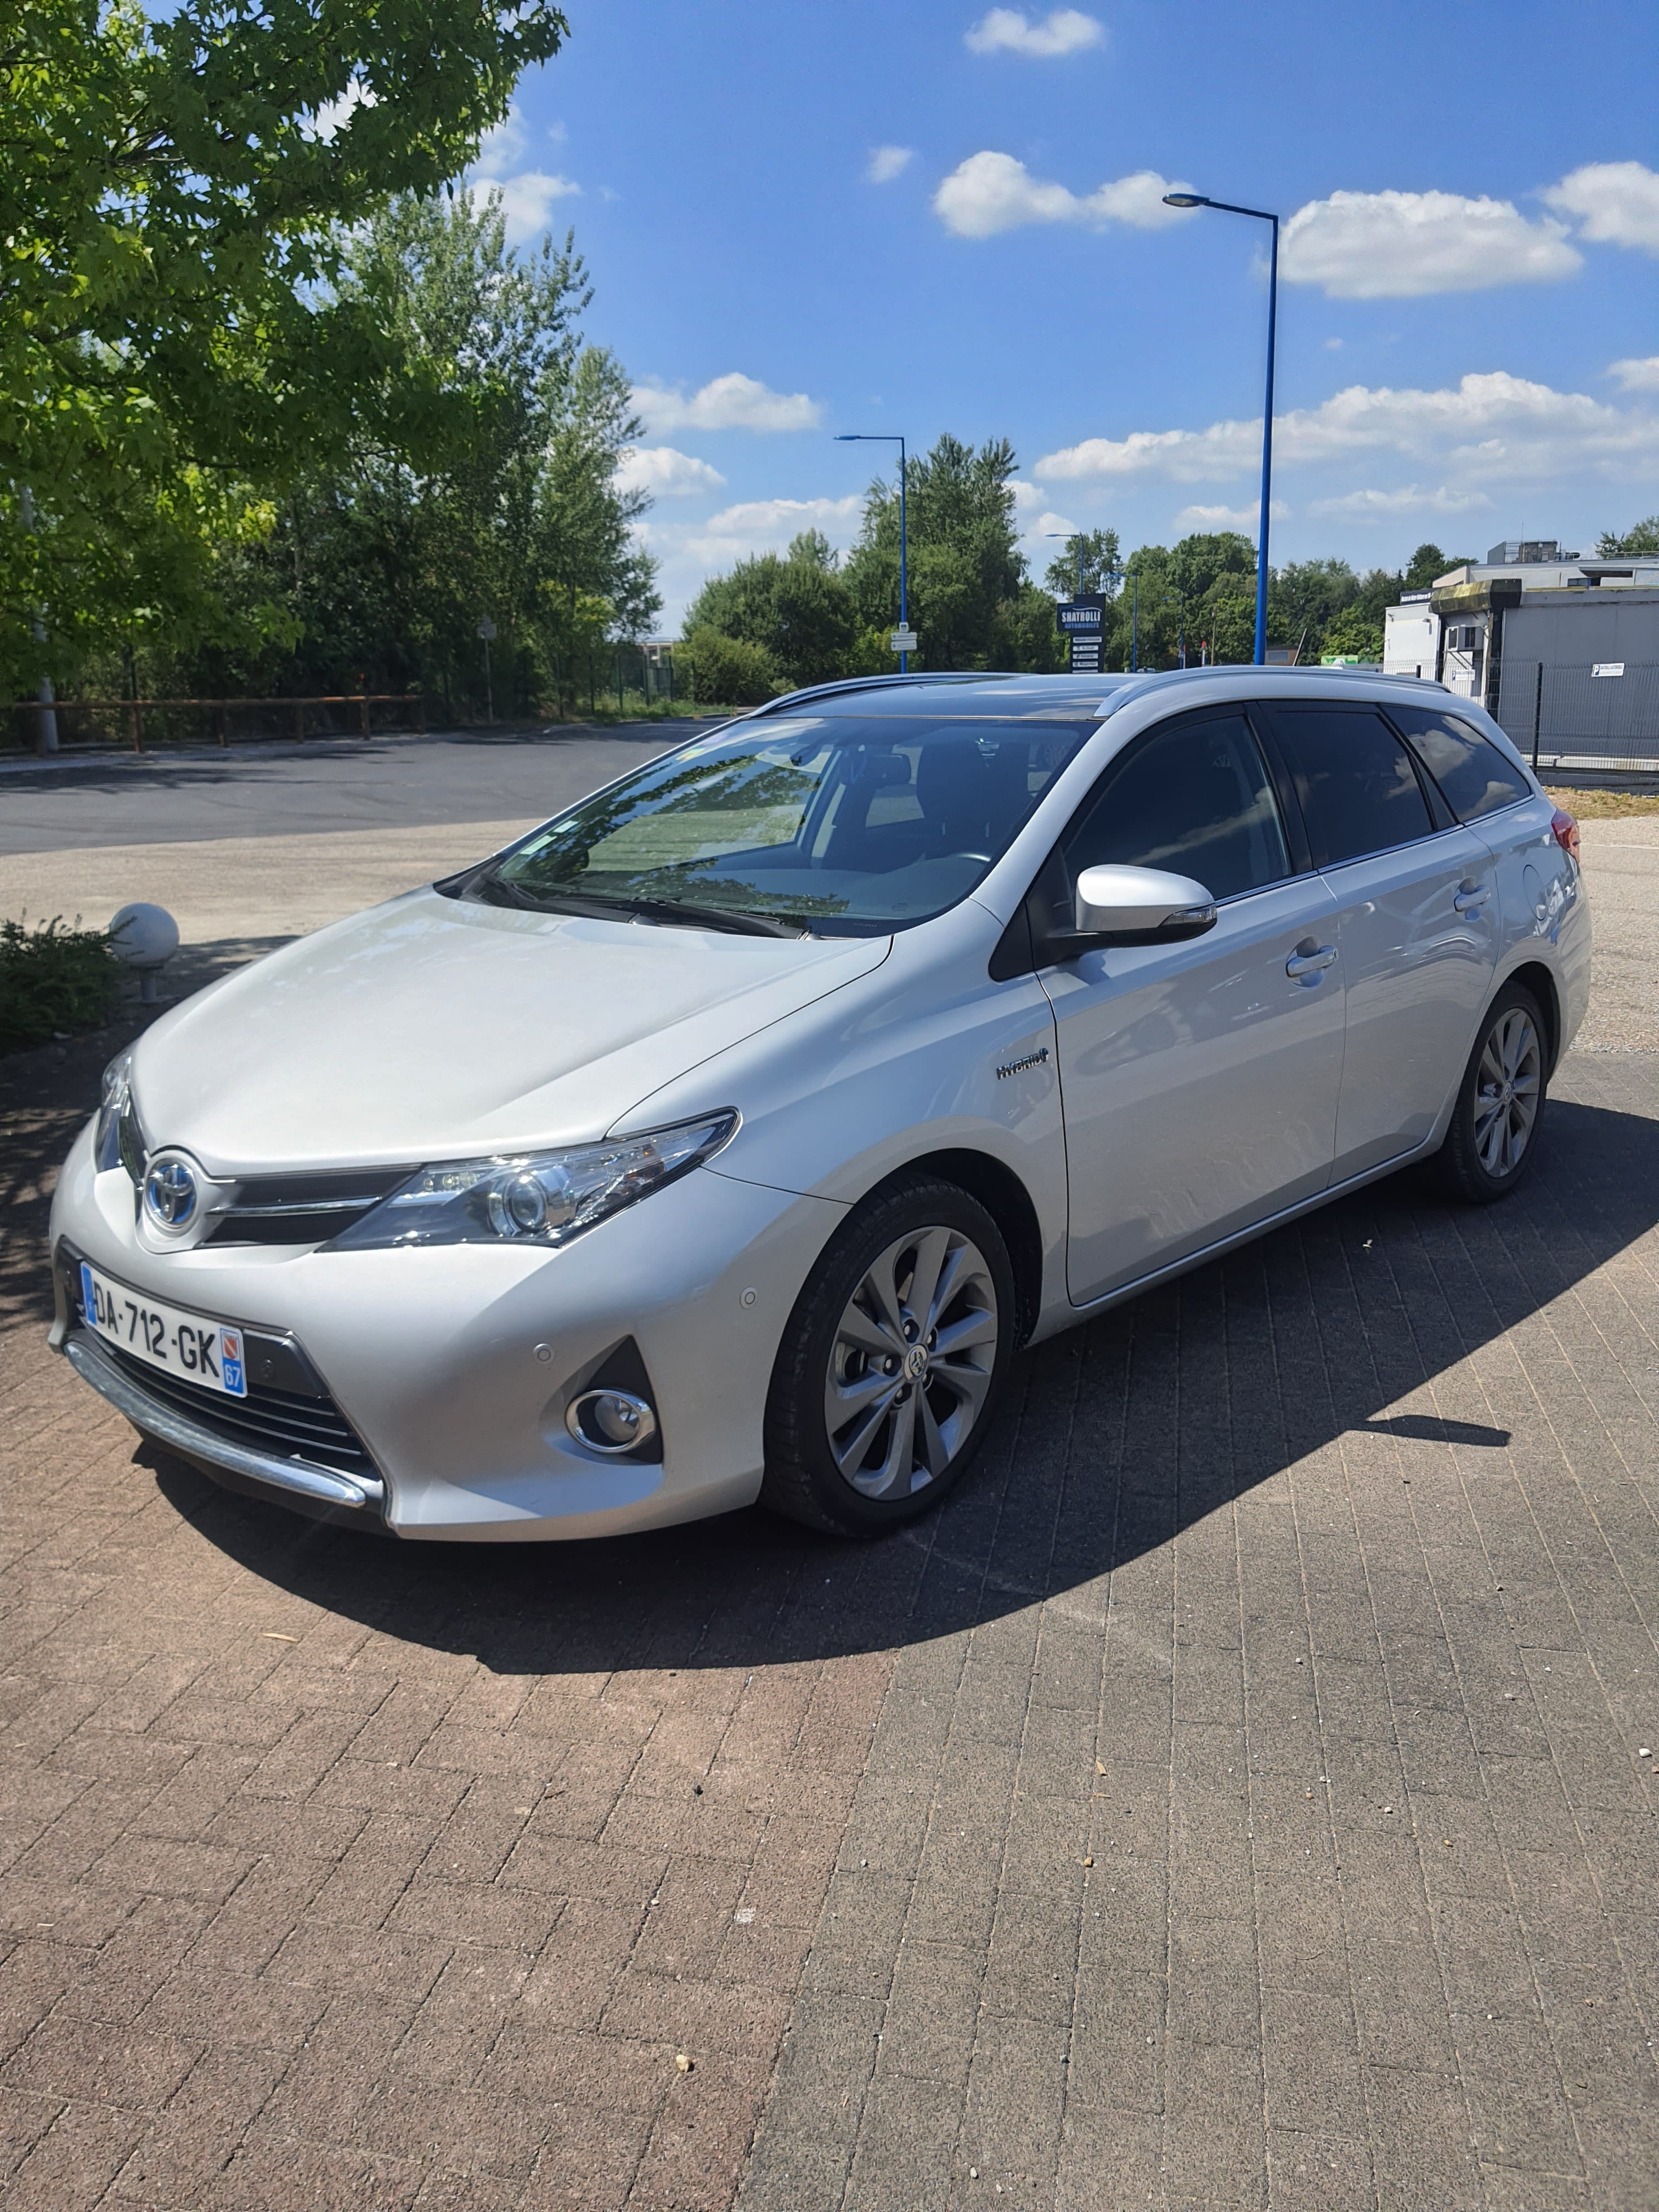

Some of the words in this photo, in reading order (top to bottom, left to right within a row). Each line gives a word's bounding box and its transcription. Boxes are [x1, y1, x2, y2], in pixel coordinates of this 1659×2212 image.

[1062, 611, 1101, 623] SHATROLLI
[996, 1053, 1043, 1080] HYBRID
[93, 1280, 219, 1378] DA-712-GK
[225, 1364, 240, 1387] 67
